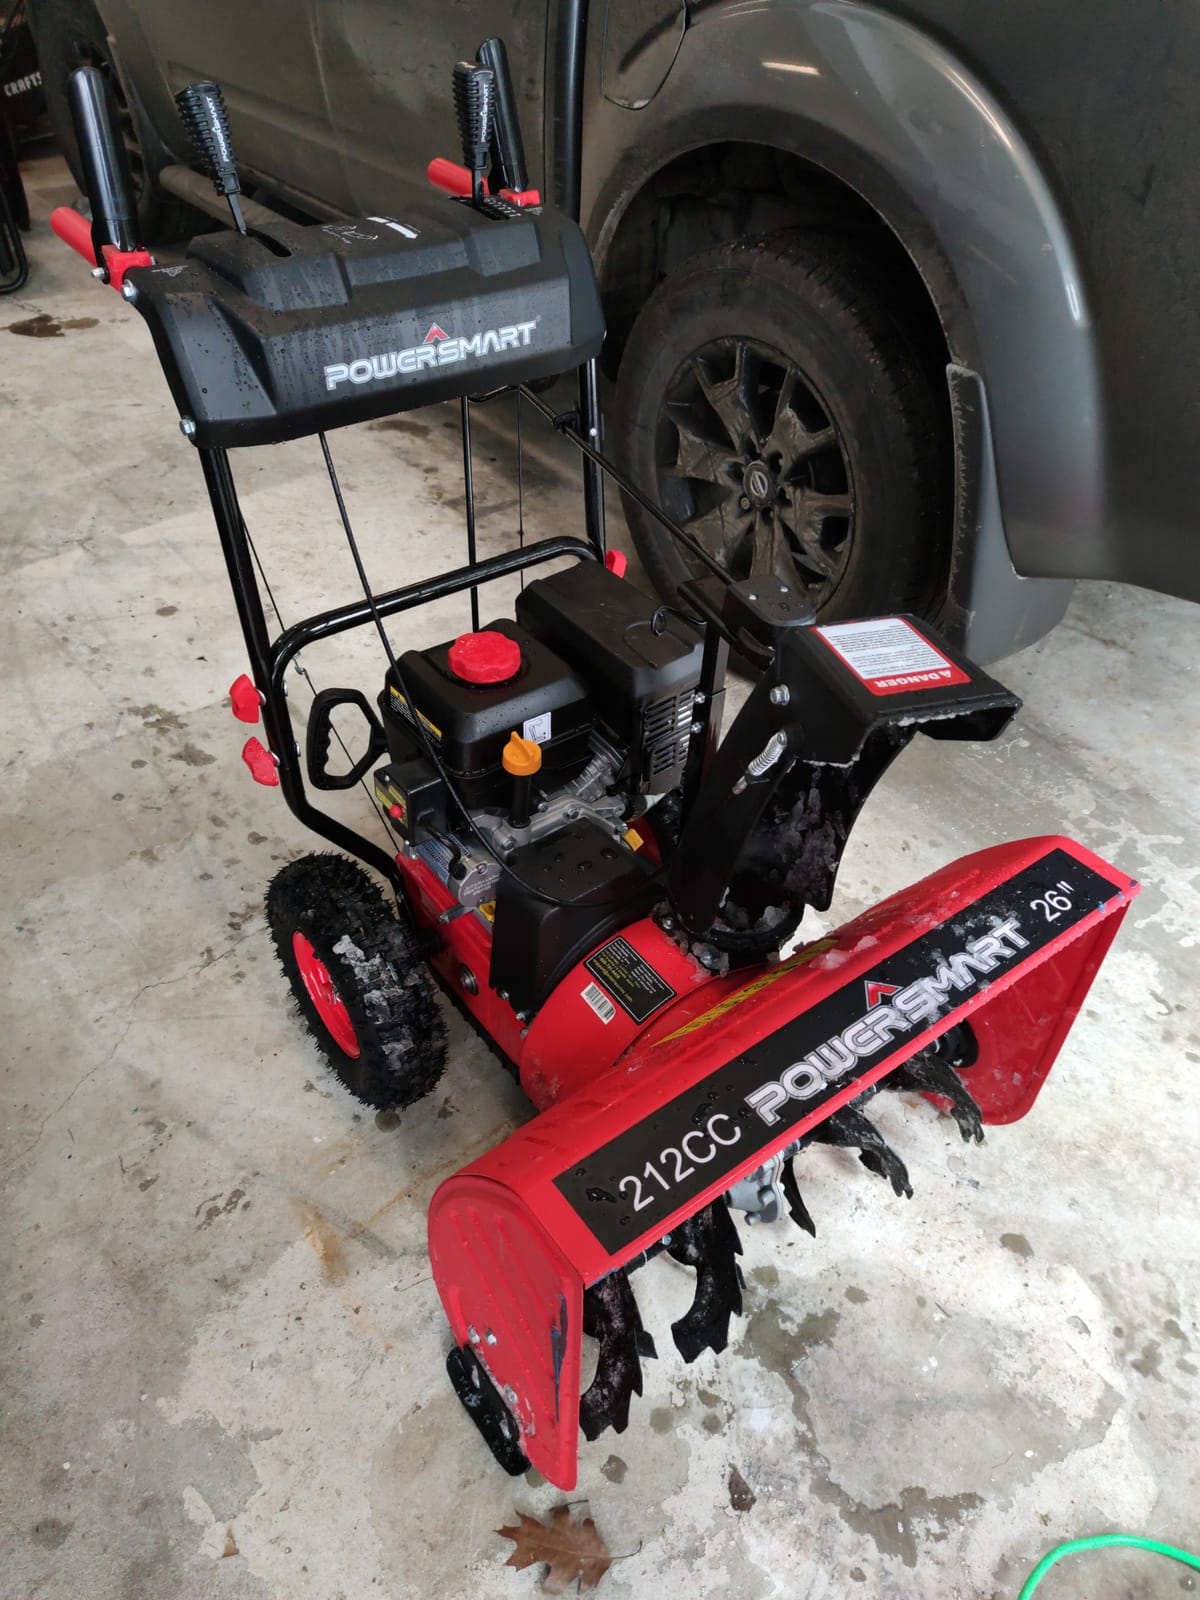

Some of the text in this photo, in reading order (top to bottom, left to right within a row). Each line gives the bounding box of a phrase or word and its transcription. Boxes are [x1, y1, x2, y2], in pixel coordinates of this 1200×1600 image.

[324, 319, 537, 391] POWERSMART
[874, 672, 941, 689] DANGER
[619, 1113, 741, 1212] 212CC
[743, 917, 1031, 1127] POWERSMART
